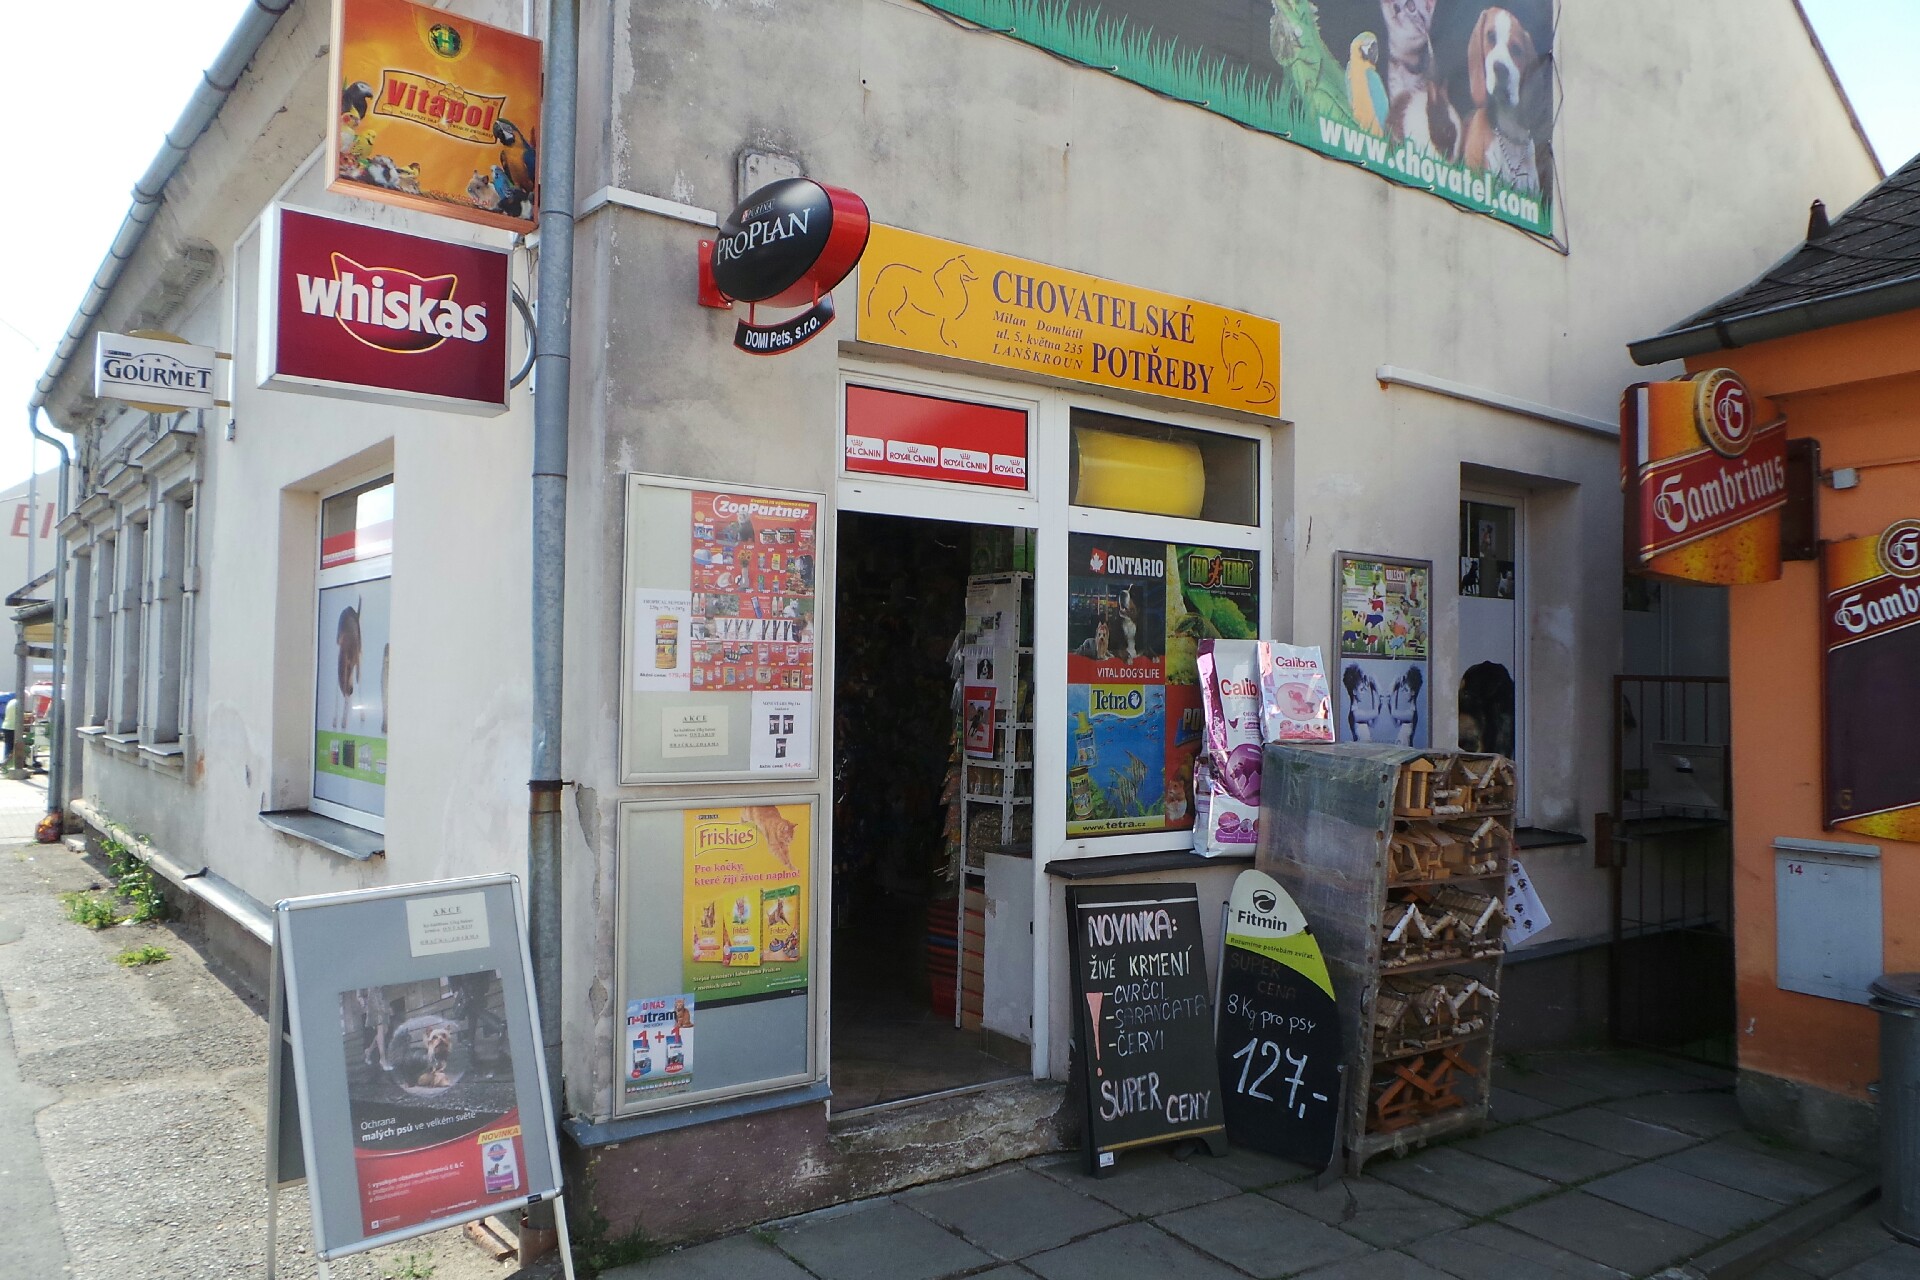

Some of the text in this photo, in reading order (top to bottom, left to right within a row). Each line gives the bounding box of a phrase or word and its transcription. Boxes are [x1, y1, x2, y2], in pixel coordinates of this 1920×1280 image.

[388, 79, 495, 131] Vitapol
[1319, 117, 1539, 224] www.chovatel.com
[296, 271, 487, 342] whiskas
[992, 269, 1195, 344] CHOVATELSKÉ
[745, 315, 820, 348] DOMI Pets, s.r.o.
[993, 310, 1084, 340] Milan Domlátil
[996, 329, 1084, 355] ul. 5. května 235
[993, 343, 1084, 370] LANŠKROUN
[104, 359, 212, 388] GOURMET
[1091, 343, 1214, 394] POTŘEBY
[858, 448, 881, 458] CANIN
[889, 452, 936, 464] ROYAL CANIN
[943, 458, 987, 471] ROYAL CANIN
[995, 464, 1015, 474] ROYAL
[1654, 455, 1785, 533] Gambrinus
[719, 500, 809, 518] ZooPartner
[1107, 555, 1164, 577] ONTARIO
[1222, 559, 1251, 588] TERRA
[1097, 667, 1160, 679] VITAL DOG'S LIFE
[1275, 656, 1317, 669] Calibra
[1093, 690, 1128, 710] Tetra
[1083, 820, 1146, 831] www.tetra.cz
[699, 827, 754, 848] Friskies
[694, 864, 711, 874] Pro
[694, 869, 801, 886] které žijí život naplno!
[1787, 863, 1803, 875] 14
[1088, 909, 1178, 948] NOVINKA:
[1237, 910, 1288, 932] Fitmin
[1263, 944, 1293, 956] potřebám
[1089, 945, 1193, 980] ŽIVÉ KRMENÍ
[1260, 1010, 1284, 1027] pro
[1289, 1014, 1316, 1034] psy
[1099, 1071, 1211, 1124] SUPER CENY
[361, 1116, 396, 1131] Ochrana
[362, 1110, 476, 1143] malých psů ve velkém světě
[481, 1126, 520, 1142] NOVINKA
